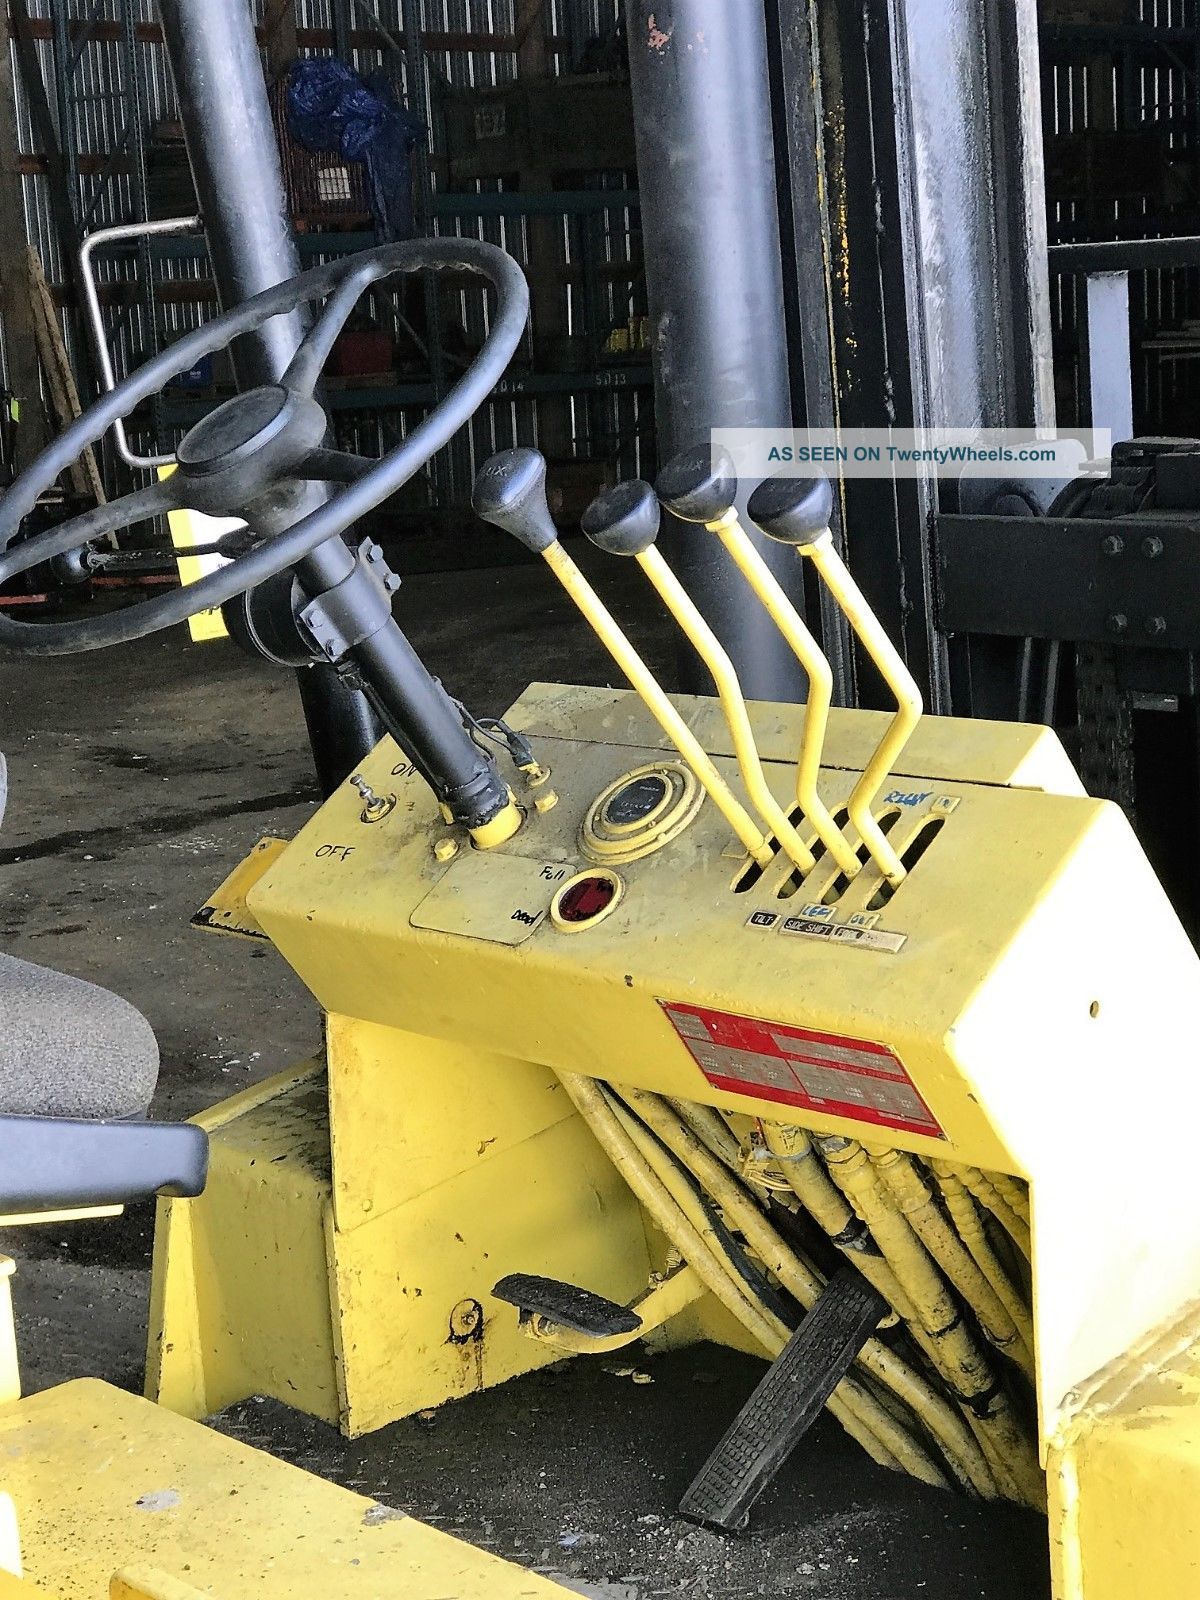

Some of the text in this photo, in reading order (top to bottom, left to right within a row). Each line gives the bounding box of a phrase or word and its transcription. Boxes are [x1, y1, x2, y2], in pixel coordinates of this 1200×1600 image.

[390, 762, 418, 778] ON
[315, 844, 356, 862] OFF
[753, 914, 774, 926] TILT
[785, 919, 804, 932] SIDE
[805, 924, 831, 936] SHIFT
